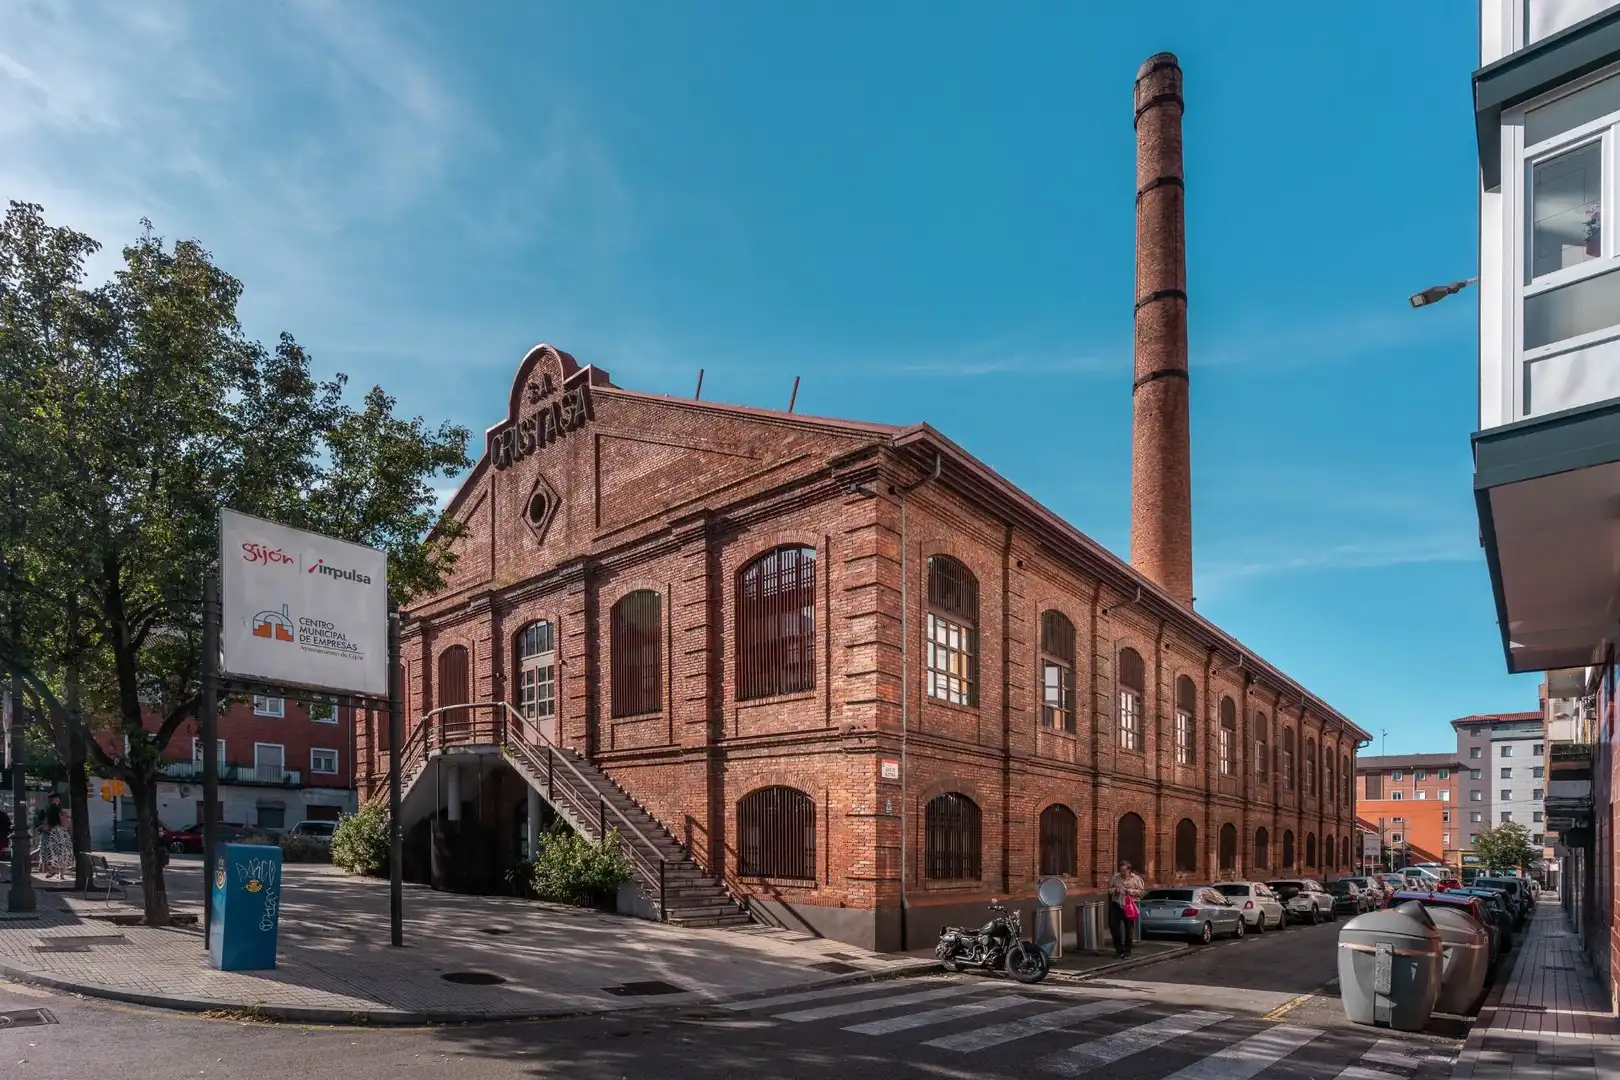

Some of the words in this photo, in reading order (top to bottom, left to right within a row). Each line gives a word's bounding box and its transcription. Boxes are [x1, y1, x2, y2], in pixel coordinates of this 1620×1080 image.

[491, 384, 592, 470] CRISTASA
[318, 559, 371, 585] impulsa
[299, 617, 334, 631] CENTRO
[299, 626, 347, 642] MUNICIPAL
[300, 634, 311, 643] DE
[313, 636, 358, 652] EMPRESAS
